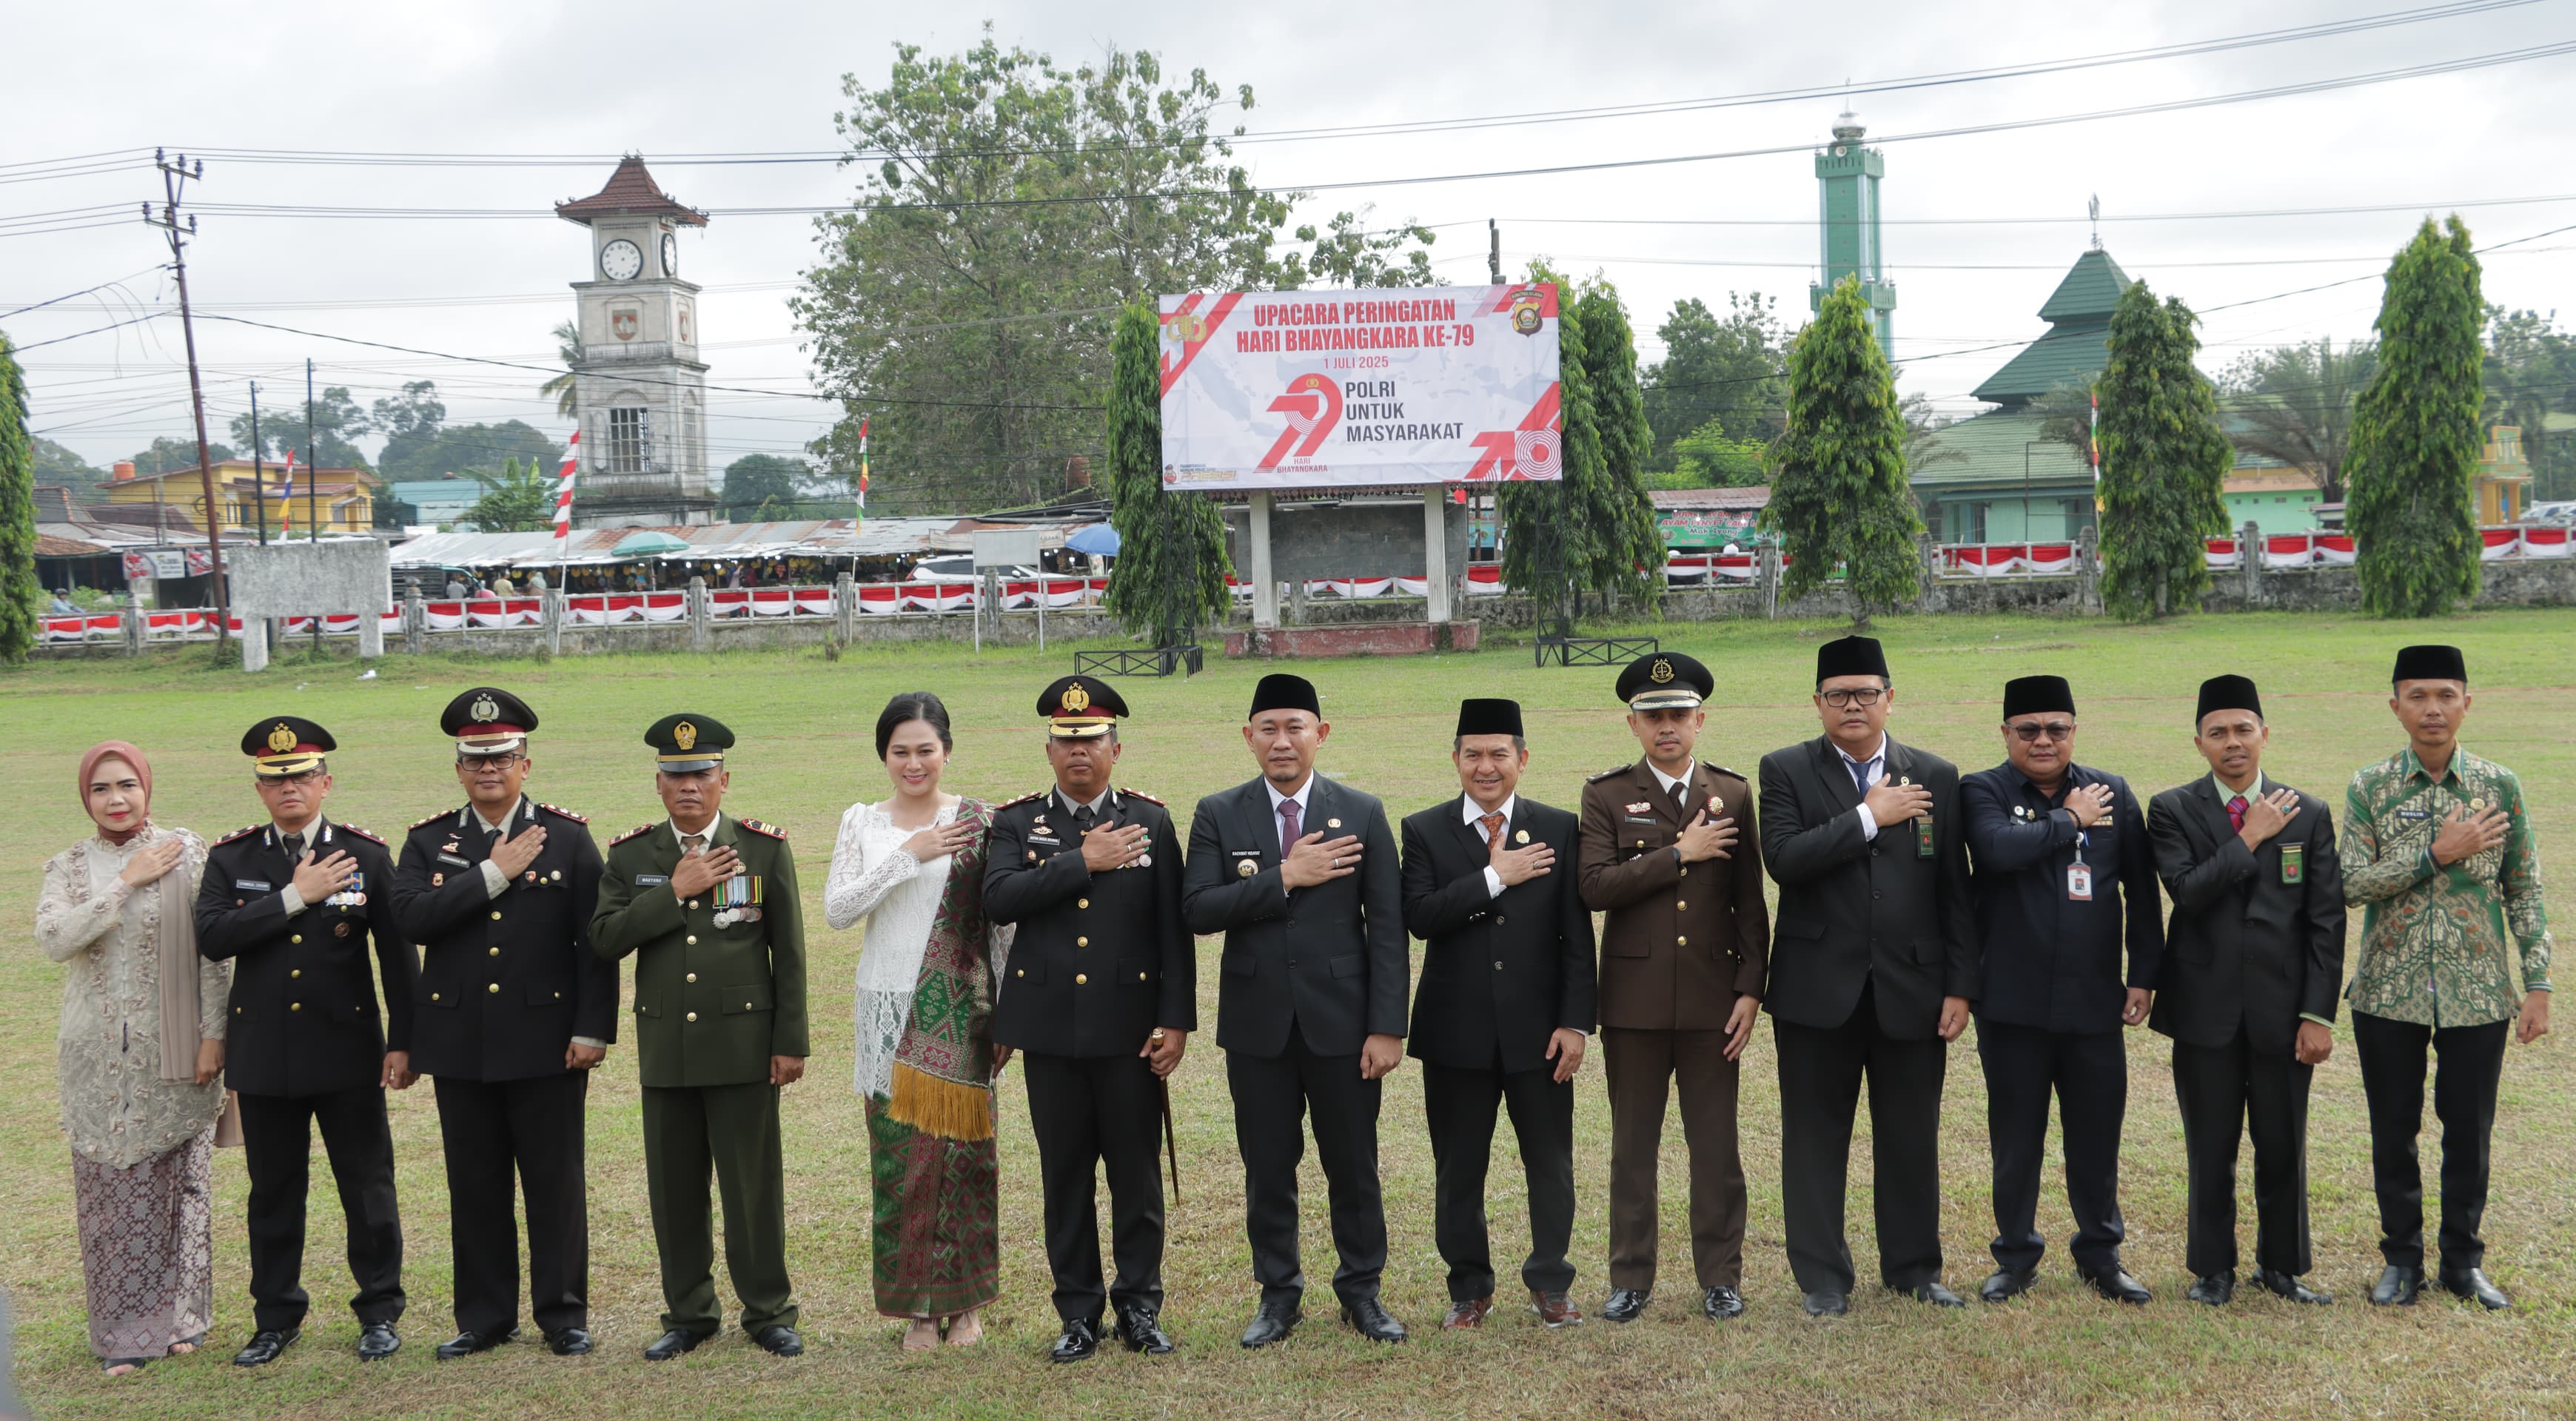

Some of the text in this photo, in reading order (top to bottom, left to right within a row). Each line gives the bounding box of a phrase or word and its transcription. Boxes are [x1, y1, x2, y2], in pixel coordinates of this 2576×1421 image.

[1254, 298, 1455, 326] UPACARA PERINGATAN
[1237, 323, 1474, 352] HARI BHAYANGKARA KE-79
[1324, 355, 1389, 369] 1 JULI 2025
[1346, 380, 1395, 398] POLRI
[1346, 402, 1404, 420] UNTUK
[1347, 423, 1463, 442] MASYARAKAT
[1277, 465, 1327, 474] BHAYANGKARA
